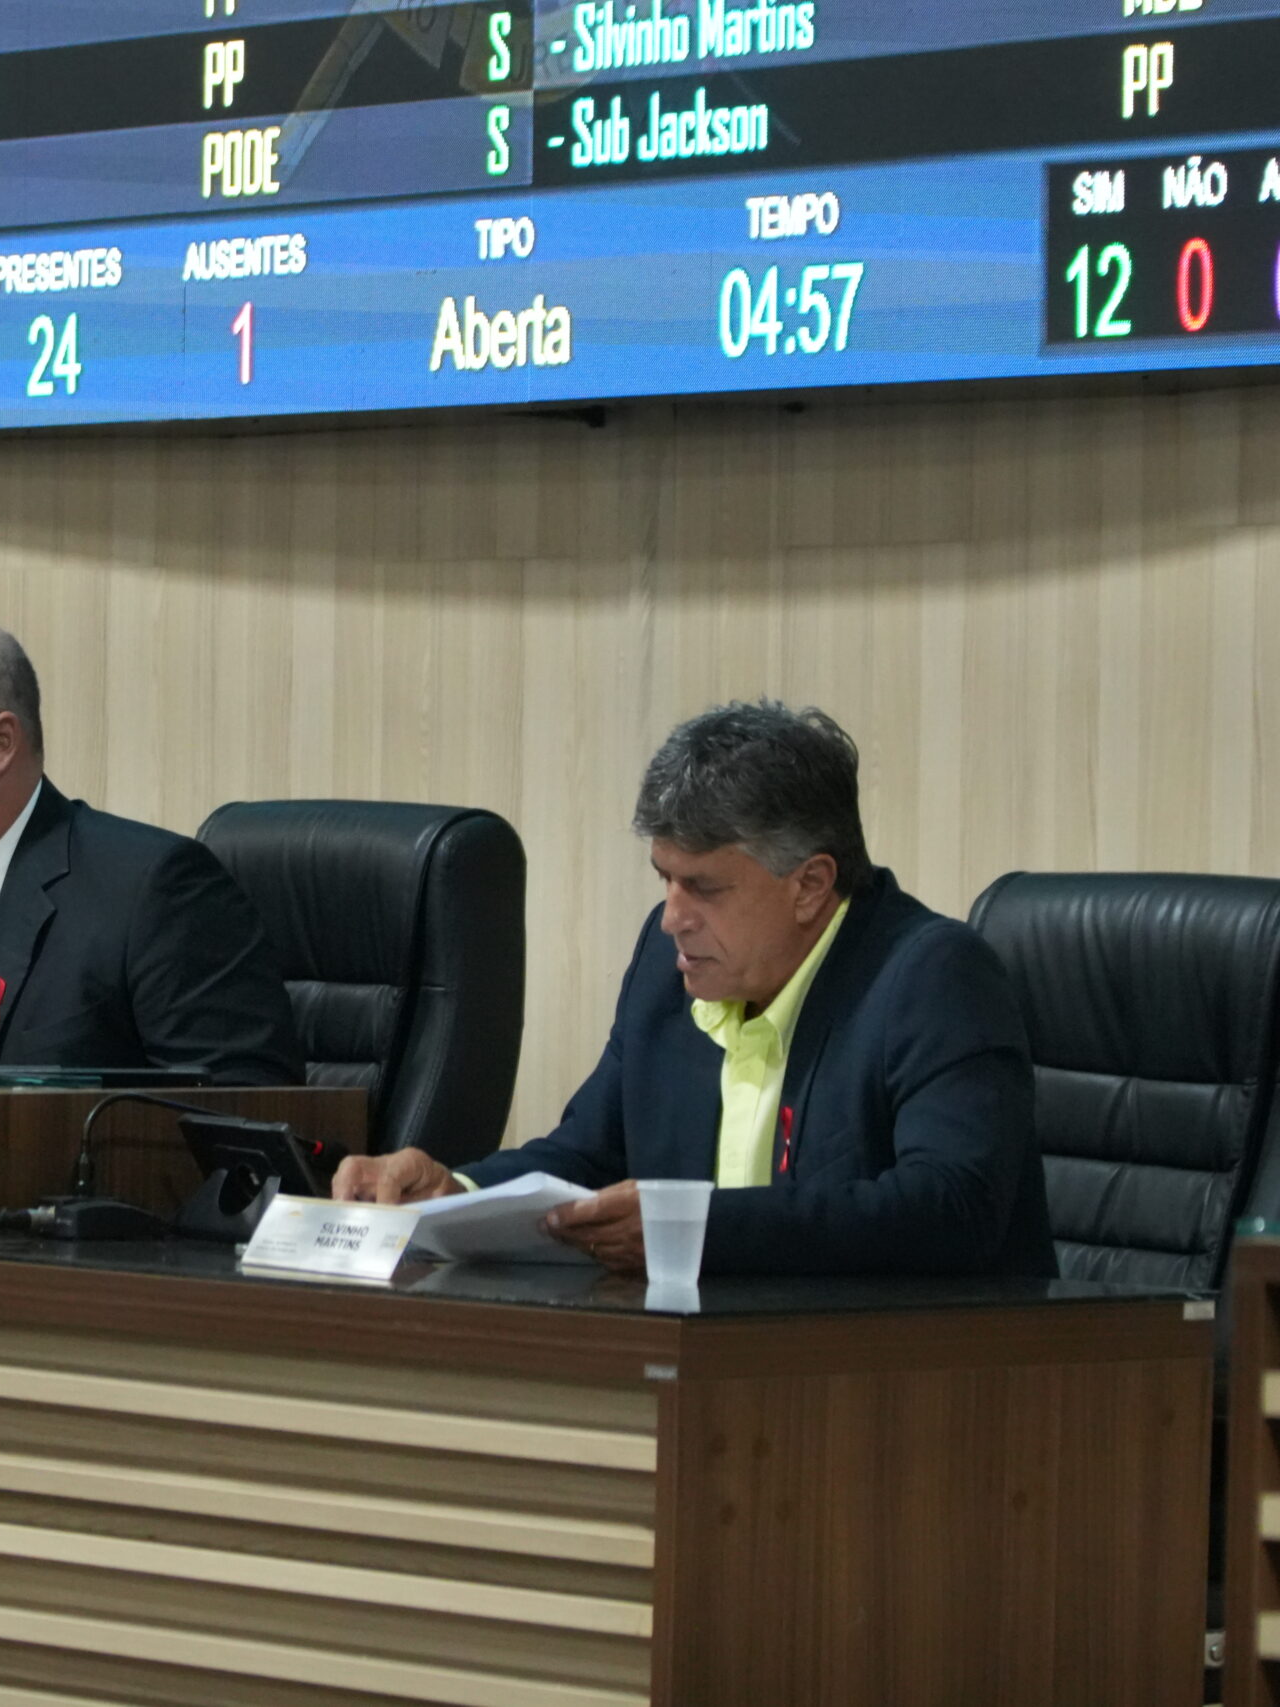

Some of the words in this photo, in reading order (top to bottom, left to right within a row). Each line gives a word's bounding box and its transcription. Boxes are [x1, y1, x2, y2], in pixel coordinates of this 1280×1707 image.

[488, 11, 512, 82] S
[572, 0, 690, 73] Silvinho
[697, 0, 815, 60] Martins
[203, 40, 245, 109] PP
[1122, 41, 1174, 118] PP
[202, 126, 281, 198] PODE
[487, 105, 510, 175] S
[571, 96, 630, 168] Sub
[637, 87, 768, 161] Jackson
[746, 193, 840, 241] TEMPO
[1072, 170, 1125, 215] SIM
[1162, 156, 1228, 209] NÃO
[182, 233, 307, 282] AUSENTES
[473, 216, 535, 261] TIPO
[718, 261, 865, 359] 04:57
[1066, 242, 1132, 338] 12
[1177, 237, 1214, 332] 0
[26, 312, 82, 397] 24
[231, 301, 254, 385] 1
[429, 294, 571, 373] Aberta
[314, 1236, 363, 1251] MARTINS
[320, 1222, 370, 1238] SILVINHO
